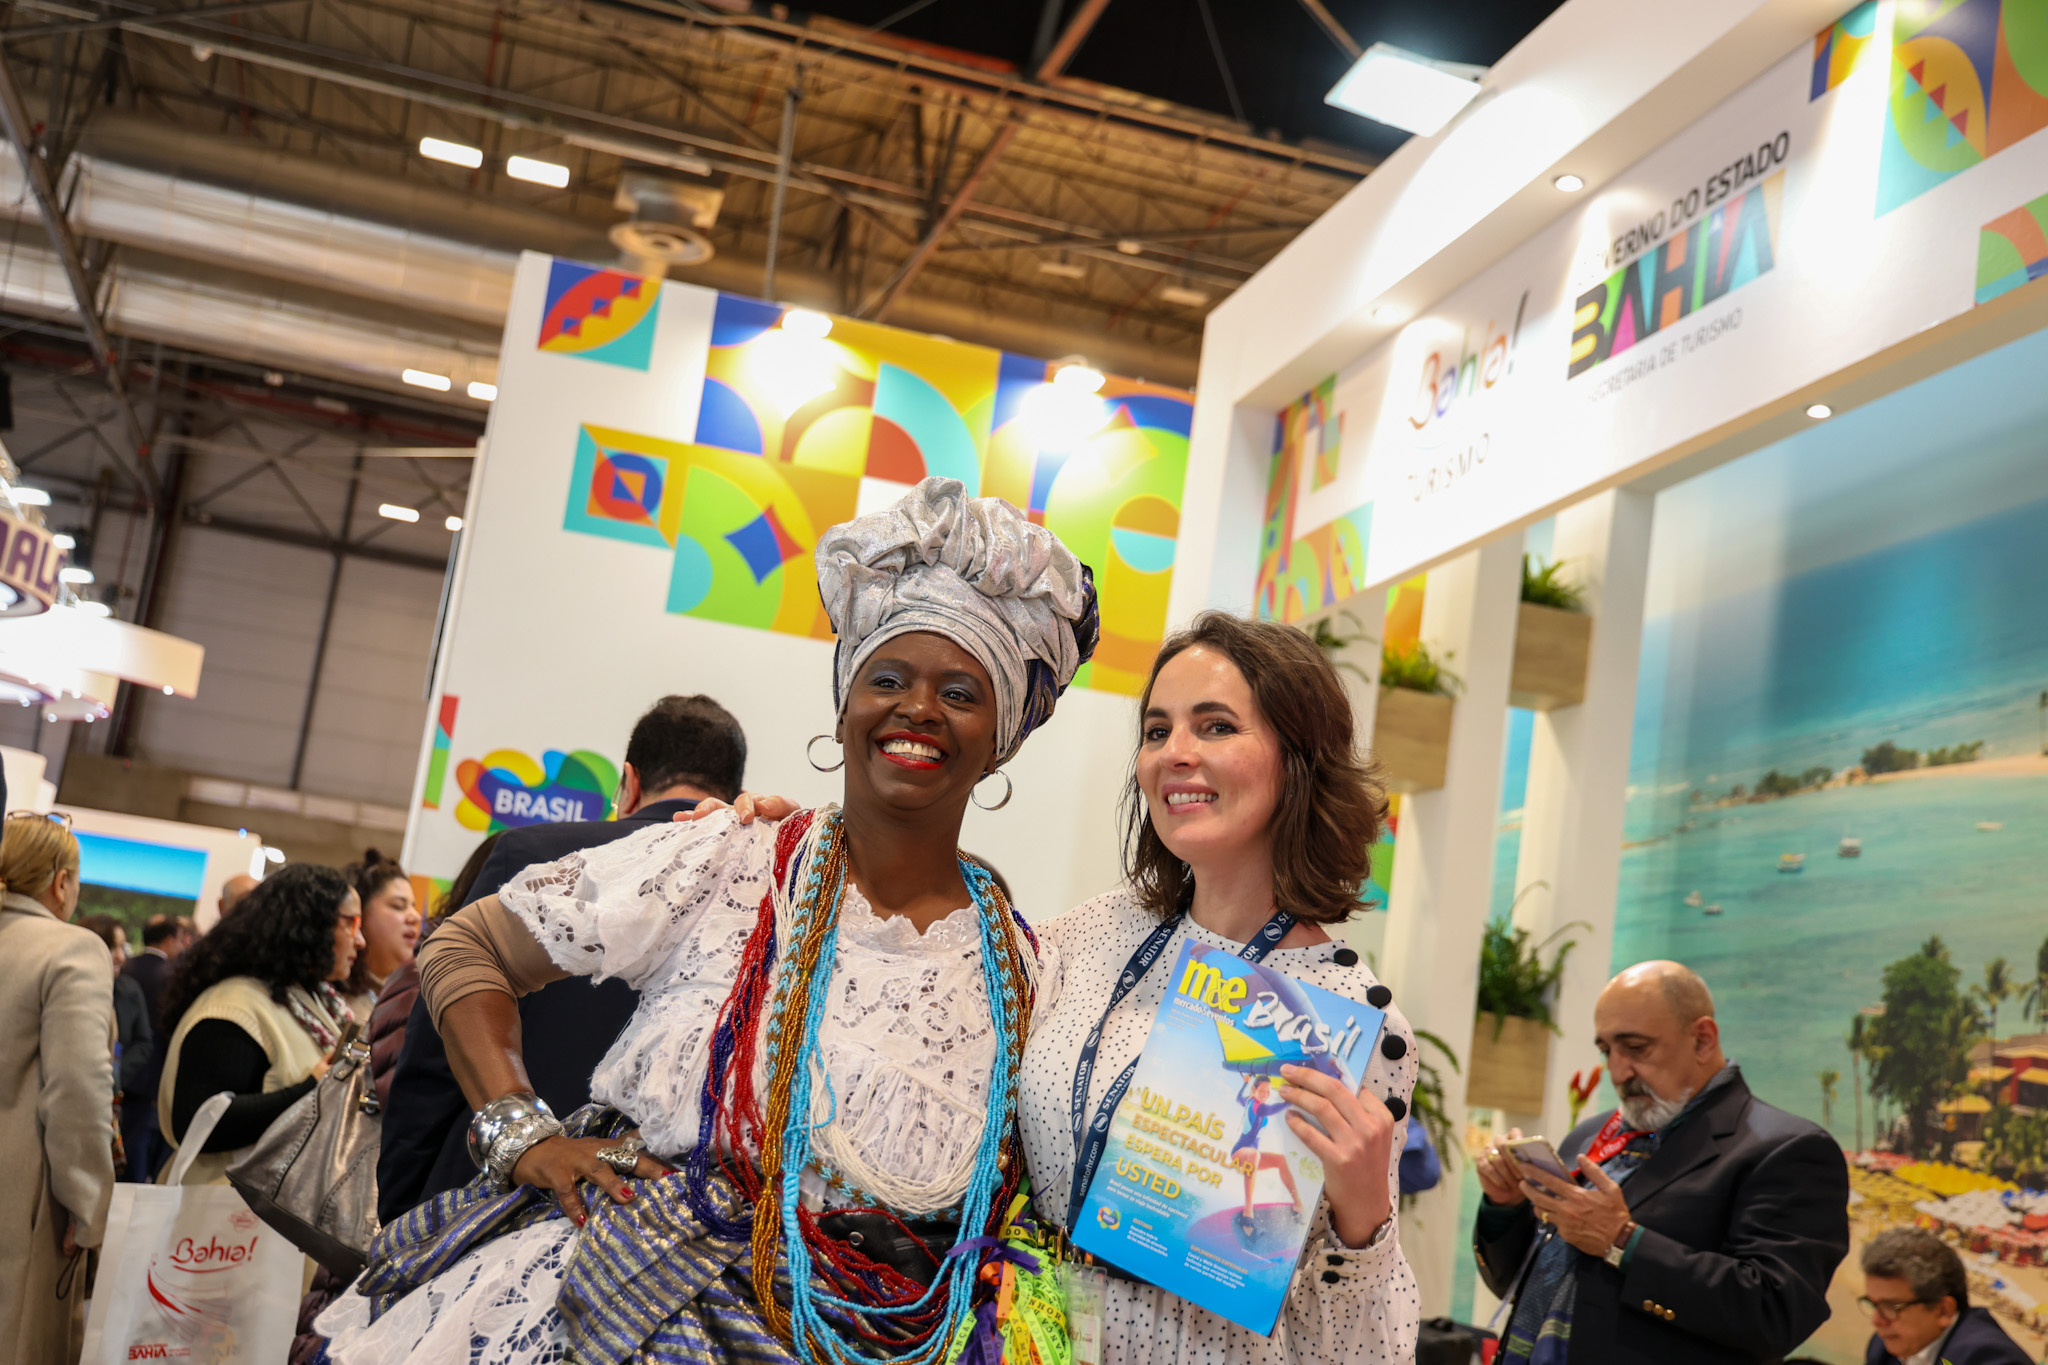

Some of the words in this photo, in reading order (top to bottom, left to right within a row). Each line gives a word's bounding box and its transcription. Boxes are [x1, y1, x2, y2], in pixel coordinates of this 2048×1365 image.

[1670, 188, 1699, 229] DO
[1705, 131, 1790, 207] ESTADO
[1567, 167, 1786, 381] BAHIA
[1659, 341, 1677, 368] DE
[1681, 307, 1743, 355] TURISMO
[494, 787, 589, 822] BRASIL
[1138, 927, 1171, 967] SENATOR
[1241, 945, 1259, 959] OR
[1177, 958, 1247, 1014] m&e
[1243, 991, 1361, 1060] Brasil
[1074, 1059, 1089, 1110] SENATOR
[1102, 1065, 1136, 1110] SENATOR
[1141, 1089, 1172, 1118] UN
[1174, 1104, 1225, 1140] PAÍS
[1079, 1141, 1099, 1197] senatorhr.com
[1124, 1134, 1182, 1171] ESPERA
[1185, 1161, 1222, 1188] POR
[1132, 1113, 1254, 1176] ESPECTACULAR
[1116, 1156, 1181, 1199] USTED
[169, 1236, 258, 1264] Bahia!
[128, 1346, 167, 1360] BAHIA
